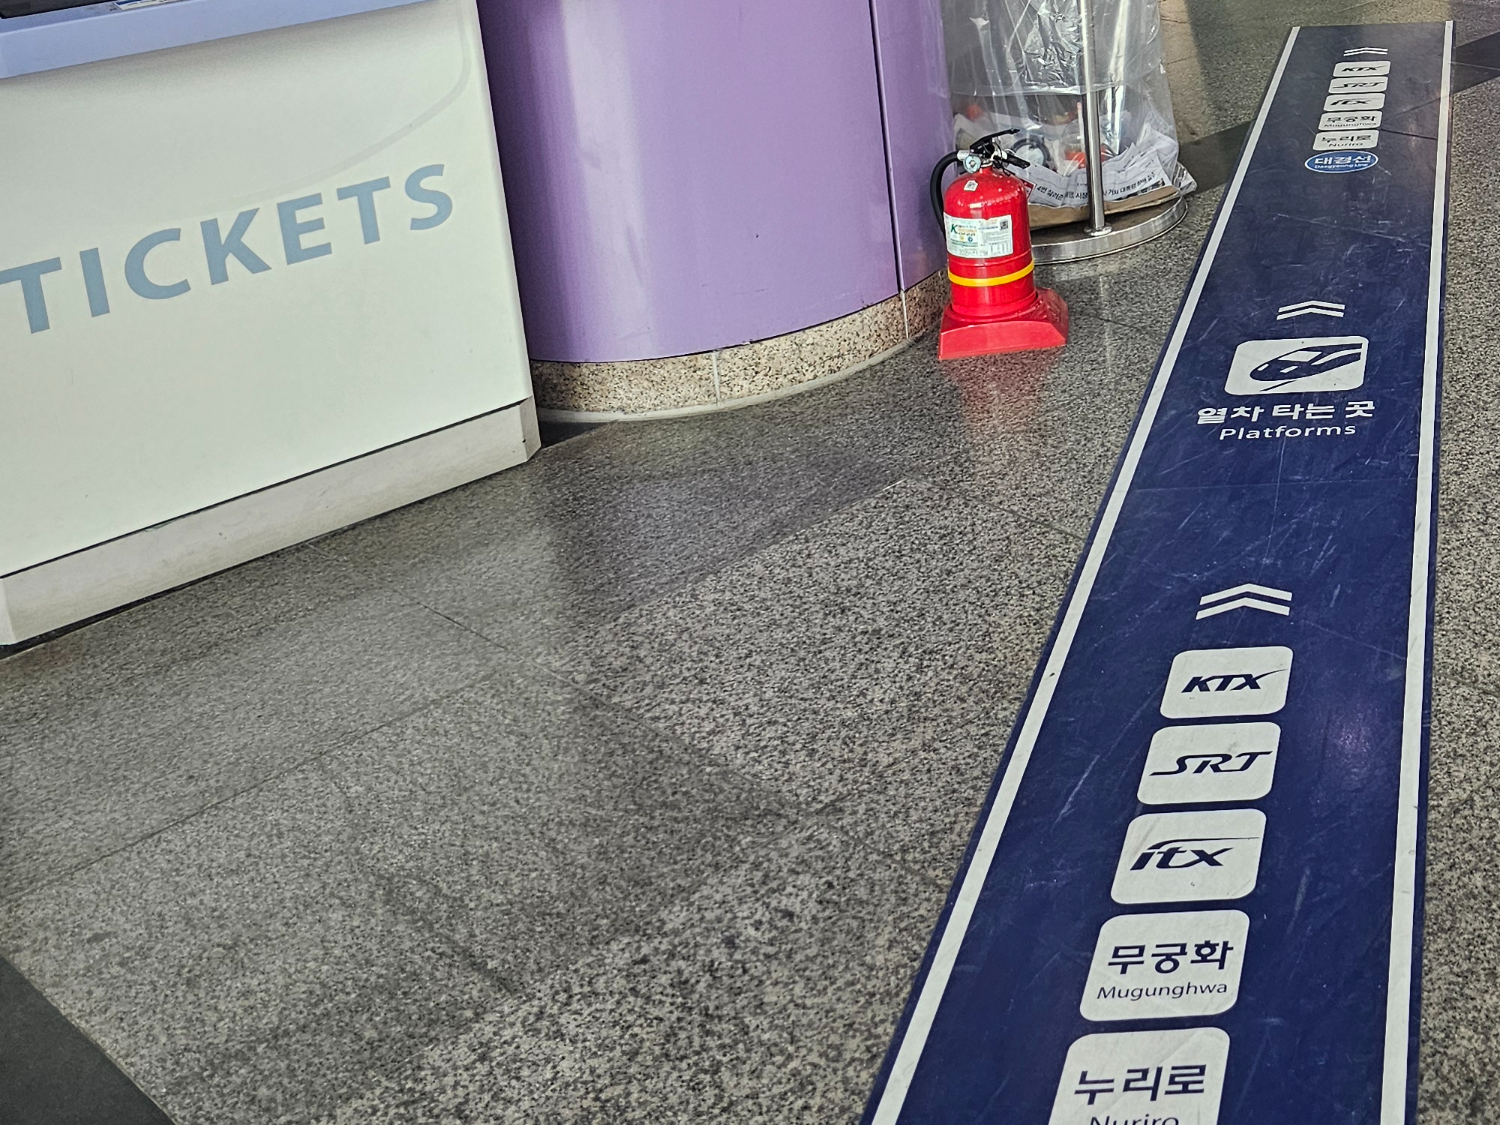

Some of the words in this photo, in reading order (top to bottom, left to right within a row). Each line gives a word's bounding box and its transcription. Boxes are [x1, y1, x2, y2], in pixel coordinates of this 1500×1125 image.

[1322, 135, 1371, 143] 누리로
[1315, 155, 1371, 165] 대경선
[0, 164, 453, 334] TICKETS
[1197, 406, 1265, 425] 열차
[1272, 403, 1335, 420] 타는
[1345, 400, 1375, 418] 곳
[1219, 425, 1356, 440] Platforms
[1181, 668, 1288, 693] KTX
[1148, 750, 1273, 776] SRT
[1108, 939, 1234, 974] 무궁화
[1096, 982, 1228, 1001] Mugunghwa
[1074, 1064, 1207, 1106] 누리로
